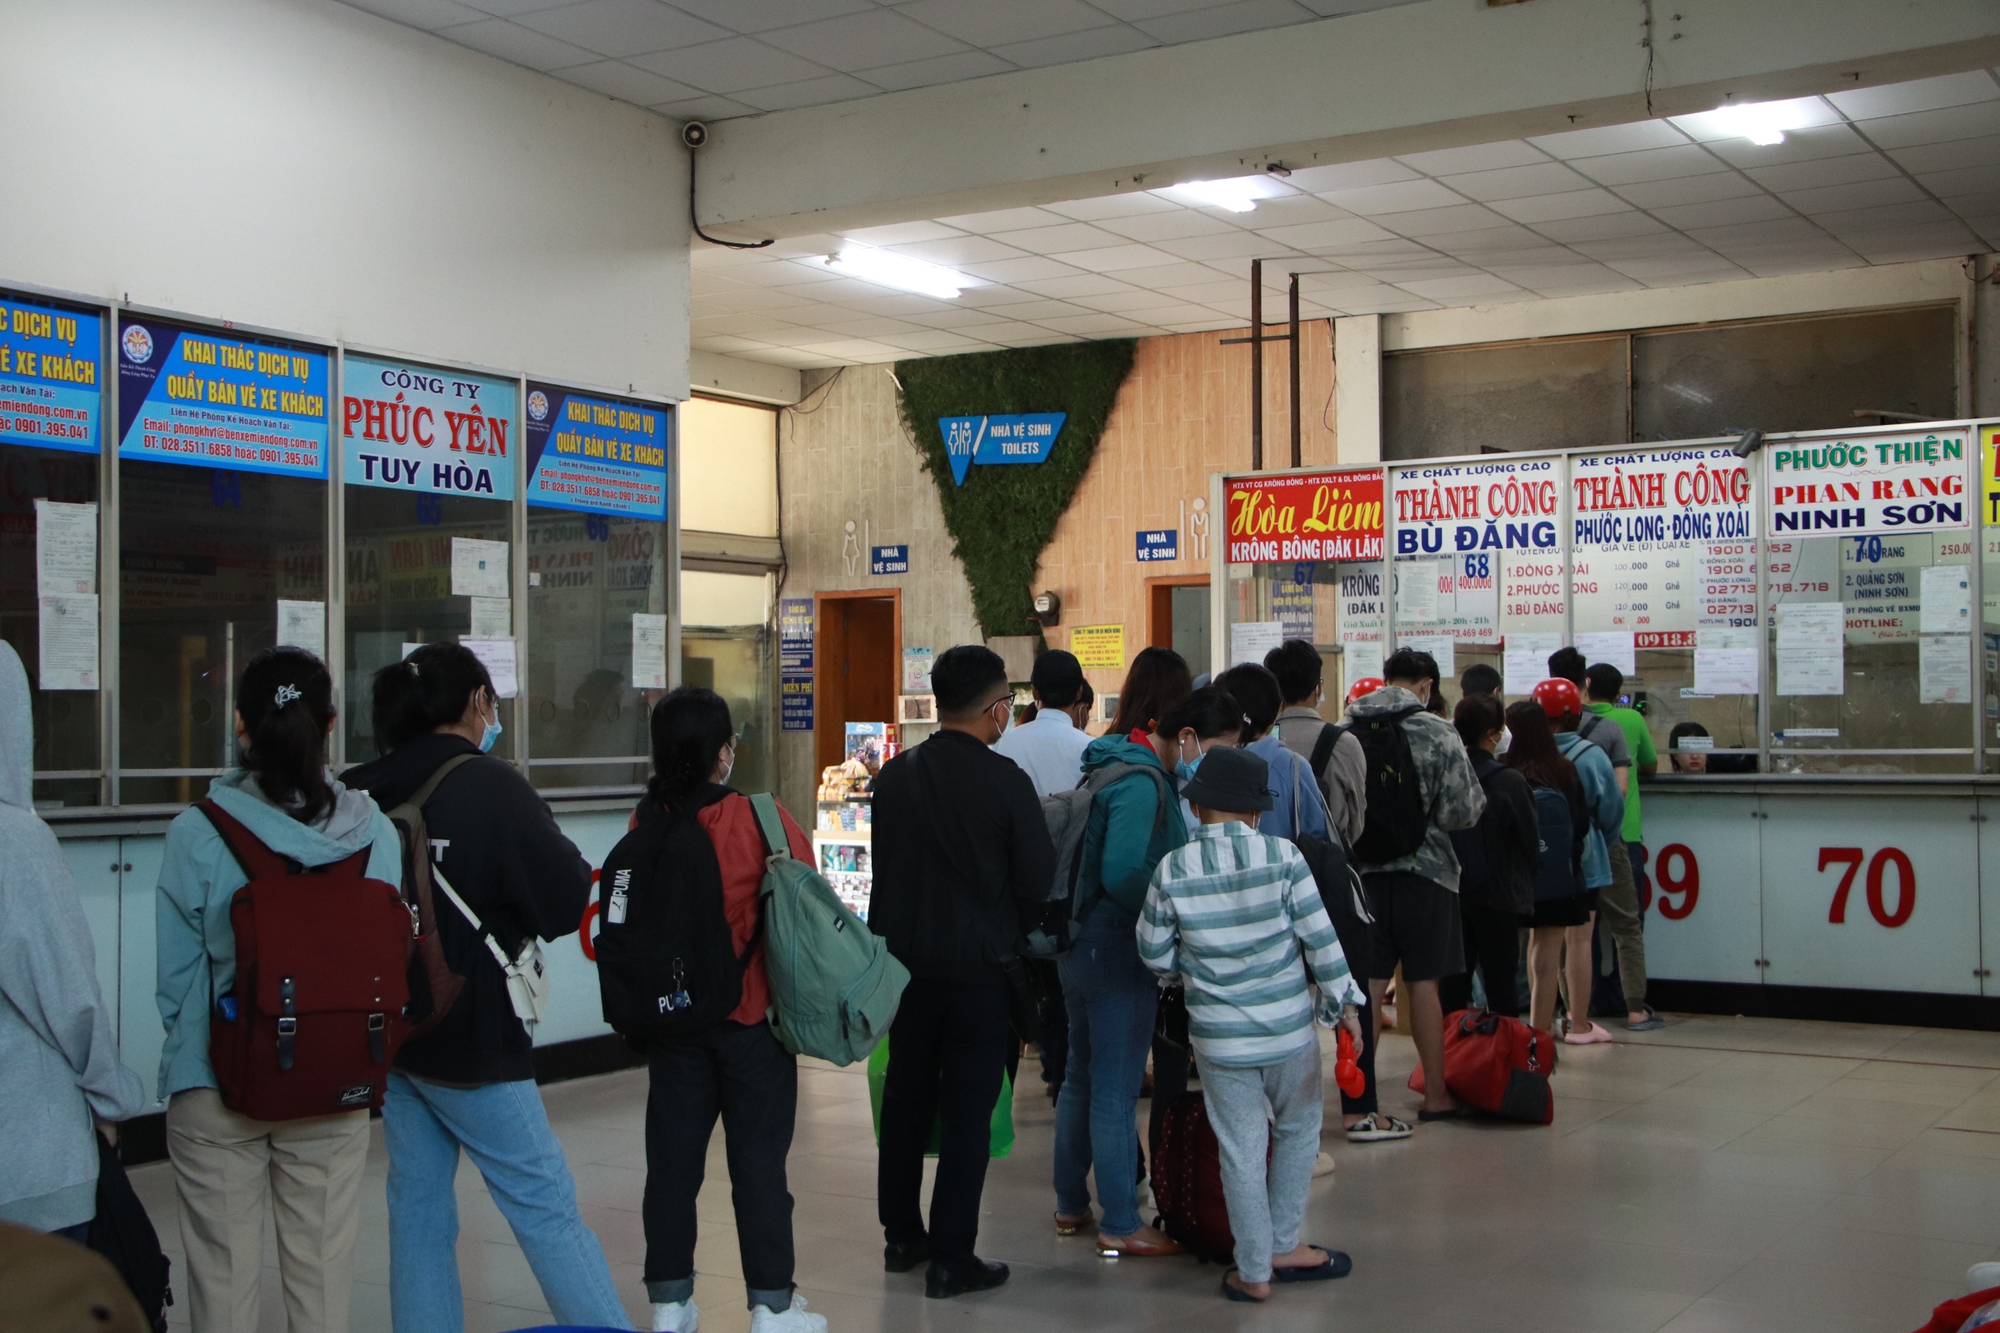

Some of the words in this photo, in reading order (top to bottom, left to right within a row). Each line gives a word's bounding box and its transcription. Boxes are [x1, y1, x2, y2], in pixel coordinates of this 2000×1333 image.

[13, 309, 51, 340] DỊCH
[56, 317, 77, 348] VỤ
[222, 320, 234, 328] 22
[16, 350, 37, 376] XE
[42, 354, 95, 385] KHÁCH
[183, 340, 216, 365] KHAI
[220, 344, 254, 371] THÁC
[258, 352, 288, 378] DỊCH
[293, 357, 309, 383] VỤ
[20, 386, 36, 398] Vận
[40, 388, 56, 398] Tải:
[167, 370, 204, 400] QUẦY
[208, 379, 237, 406] BÁN
[240, 384, 256, 408] VÉ
[260, 387, 277, 410] XE
[282, 389, 324, 417] KHÁCH
[381, 369, 445, 394] CÔNG
[452, 382, 480, 399] TY
[15, 418, 88, 440] 0901.395.041
[171, 408, 188, 417] Liên
[190, 410, 200, 419] Hệ
[202, 411, 225, 423] Phòng
[227, 414, 237, 423] Kế
[239, 416, 262, 427] Hoạch
[264, 419, 277, 429] Vận
[344, 392, 434, 448] PHÚC
[444, 404, 508, 457] YÊN
[568, 401, 590, 423] KHAI
[594, 405, 617, 427] THÁC
[620, 411, 640, 433] DỊCH
[643, 415, 654, 438] VỤ
[144, 418, 172, 432] Email:
[174, 423, 318, 450] phongkhvt@benxemiendong.com.vn
[990, 424, 1011, 438] NHÀ
[1014, 422, 1025, 439] VỆ
[1028, 424, 1051, 437] SINH
[144, 435, 158, 449] ĐT:
[162, 437, 232, 457] 028.3511.6858
[235, 446, 257, 462] hoặc
[260, 450, 318, 467] 0901.395.041
[556, 428, 582, 454] QUẦY
[584, 434, 604, 458] BÁN
[607, 438, 618, 460] VÉ
[620, 443, 632, 462] XE
[635, 443, 664, 467] KHÁCH
[1001, 442, 1039, 455] TOILETS
[1580, 458, 1598, 467] XE
[1604, 453, 1646, 465] CHẤT
[1652, 450, 1705, 463] LƯỢNG
[1775, 442, 1867, 471] PHƯỚC
[1875, 435, 1962, 466] THIỆN
[360, 455, 421, 485] TUY
[433, 460, 494, 493] HÒA
[540, 468, 559, 478] Email:
[1264, 479, 1285, 487] KRÔNG
[1286, 478, 1303, 486] BÔNG
[1308, 477, 1320, 485] HTX
[1321, 476, 1337, 484] XKLT
[1401, 471, 1418, 479] XE
[1423, 466, 1462, 478] CHẤT
[1466, 464, 1516, 476] LƯỢNG
[1520, 462, 1550, 471] CAO
[540, 480, 550, 490] ĐT:
[552, 482, 600, 496] 028.3511.6858
[602, 488, 618, 500] hoặc
[620, 491, 660, 504] 0901.395.041
[1395, 479, 1480, 522] THÀNH
[1488, 475, 1558, 517] CÔNG
[1574, 466, 1666, 512] THÀNH
[1674, 462, 1750, 506] CÔNG
[1773, 482, 1860, 505] PHAN
[1872, 475, 1963, 499] RANG
[416, 492, 442, 525] 65
[1230, 490, 1297, 536] Hòa
[1302, 485, 1384, 533] Liêm
[1775, 508, 1865, 531] NINH
[1882, 500, 1961, 526] SƠN
[1576, 512, 1622, 544] PHƯỚC
[1626, 515, 1664, 542] LONG
[1672, 508, 1711, 540] ĐỒNG
[1717, 503, 1749, 538] XOÀI
[1146, 530, 1167, 544] NHÀ
[1232, 538, 1278, 562] KRÔNG
[1282, 535, 1320, 560] BÔNG
[1322, 536, 1351, 560] (ĐĂK
[1356, 534, 1384, 559] LĂK)
[1398, 522, 1442, 554] BÙ
[1455, 519, 1556, 551] ĐĂNG
[882, 548, 899, 558] NHÀ
[1138, 547, 1150, 561] VỆ
[1152, 547, 1175, 558] SINH
[1707, 546, 1743, 555] 1900
[1854, 536, 1882, 562] 70
[1882, 546, 1905, 558] RANG
[874, 561, 886, 574] VỆ
[886, 561, 906, 572] SINH
[1294, 562, 1317, 585] 67
[1465, 554, 1489, 578] 68
[1665, 559, 1680, 569] Ghế
[1707, 565, 1743, 575] 1900
[1342, 569, 1380, 597] KRÔNG
[1665, 582, 1680, 590] Ghế
[1846, 576, 1854, 586] 2.
[1856, 570, 1885, 587] QUẢNG
[1888, 571, 1904, 584] SƠN
[1854, 588, 1882, 600] (NINH
[1885, 587, 1908, 598] SƠN)
[1348, 601, 1376, 615] (ĐĂK
[1534, 603, 1564, 615] ĐĂNG
[1665, 602, 1680, 610] Ghế
[1359, 619, 1378, 628] Xuất
[1613, 617, 1625, 625] GN:
[1846, 618, 1903, 628] HOTLINE:
[1344, 632, 1355, 641] ĐT
[613, 868, 632, 897] PUMA
[1818, 847, 1916, 928] 70
[658, 989, 692, 1014] PUA
